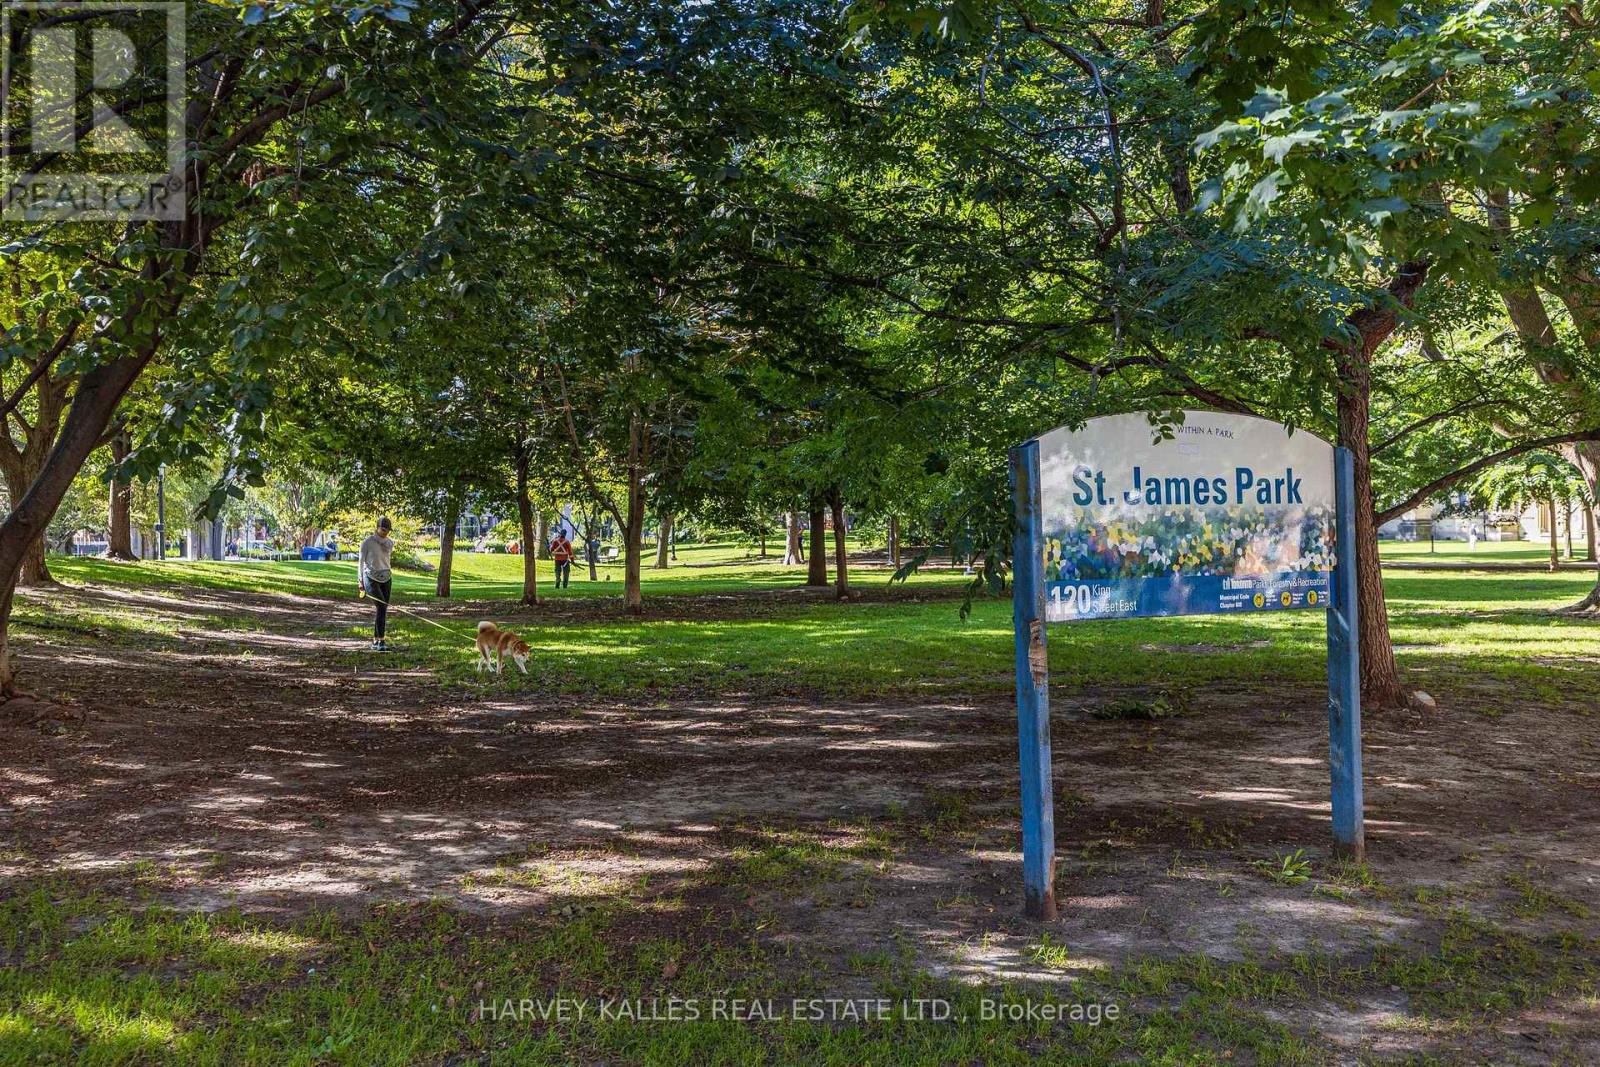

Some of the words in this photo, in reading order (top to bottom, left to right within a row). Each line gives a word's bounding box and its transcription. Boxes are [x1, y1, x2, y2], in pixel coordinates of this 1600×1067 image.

[1178, 426, 1205, 434] WITHIN
[1208, 427, 1213, 435] A
[1215, 428, 1234, 439] PARK
[1072, 464, 1115, 506] St.
[1123, 466, 1228, 506] James
[1235, 467, 1303, 505] Park
[1298, 577, 1328, 587] Recreation
[1092, 584, 1111, 600] King
[1051, 584, 1091, 615] 120
[1119, 599, 1137, 612] East
